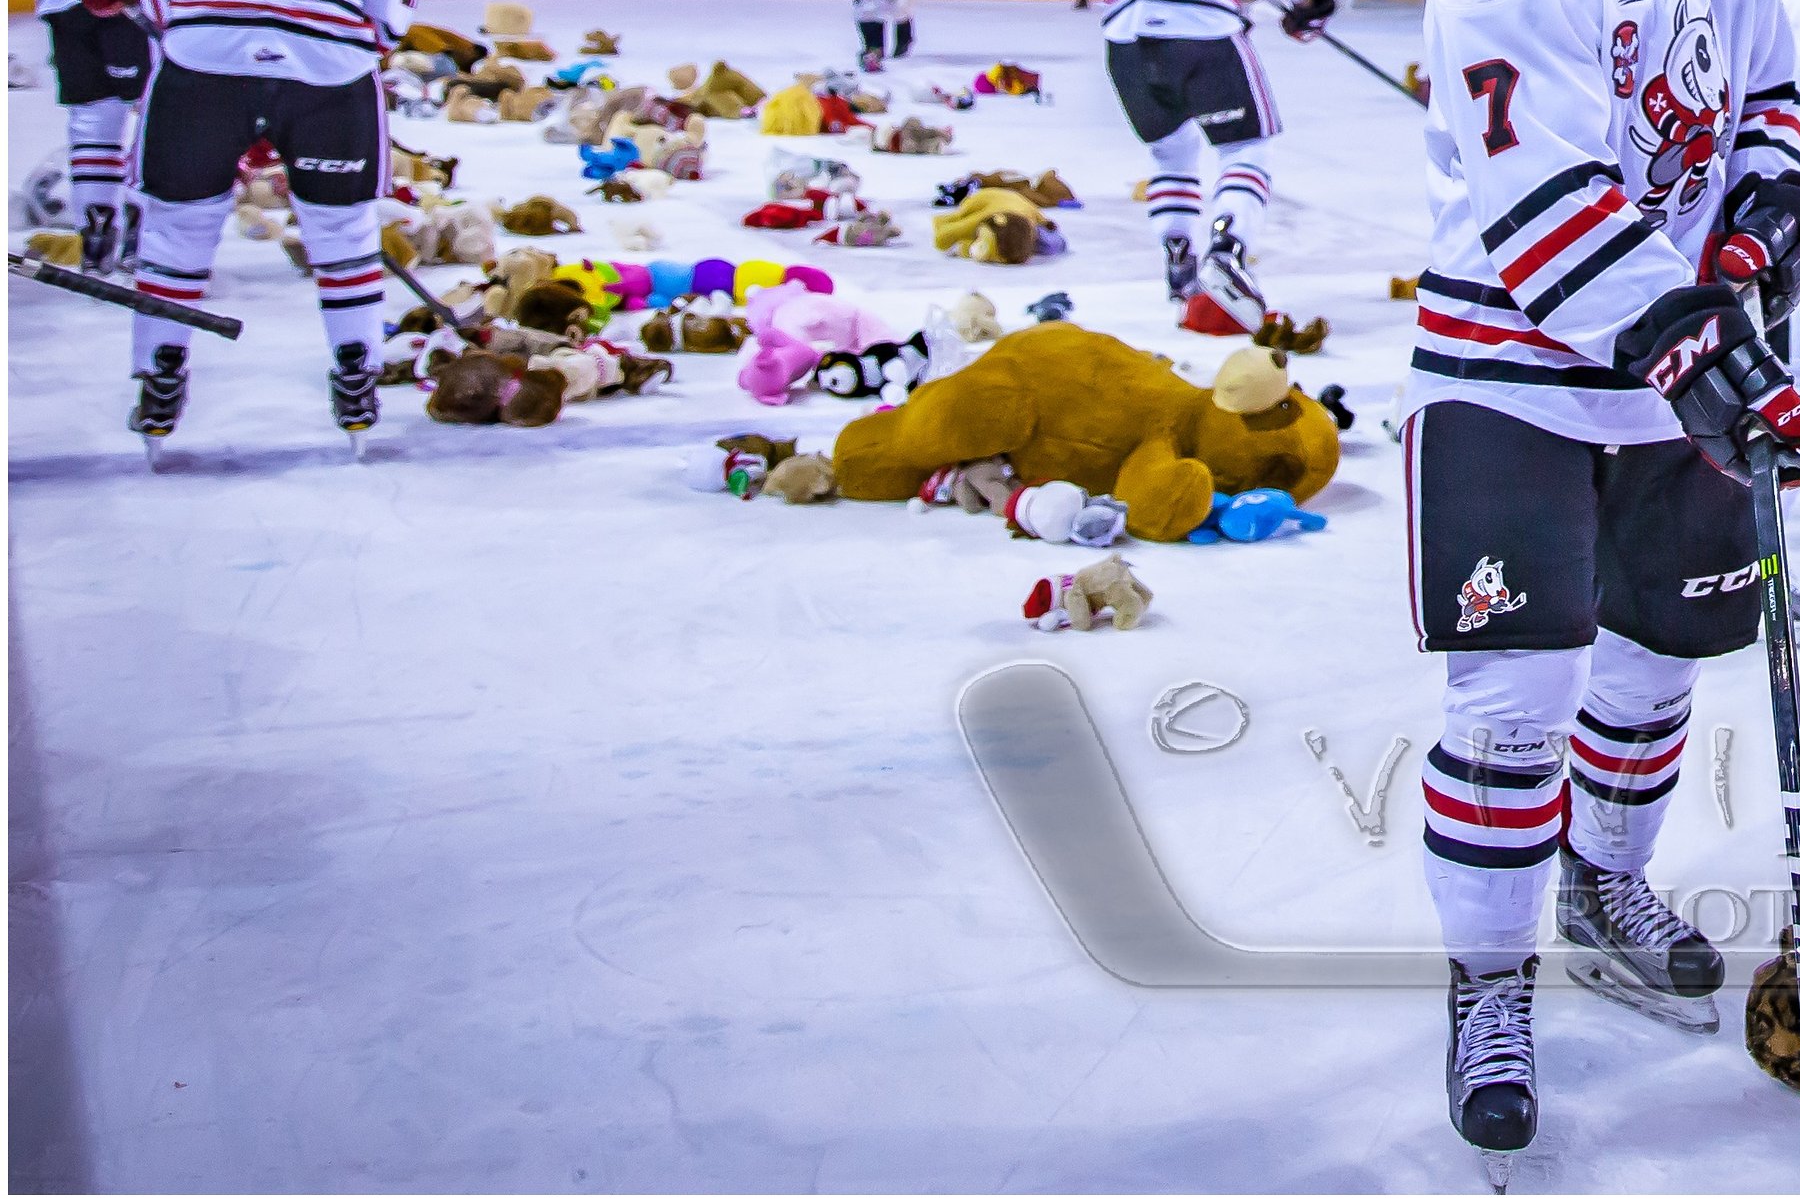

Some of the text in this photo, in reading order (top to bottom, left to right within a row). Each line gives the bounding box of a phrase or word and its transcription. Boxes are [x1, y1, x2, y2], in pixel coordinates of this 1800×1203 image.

[1462, 58, 1520, 158] 7
[295, 157, 367, 174] CCM
[1721, 244, 1759, 271] CCM
[1646, 314, 1721, 397] CM
[1493, 740, 1546, 754] CCM
